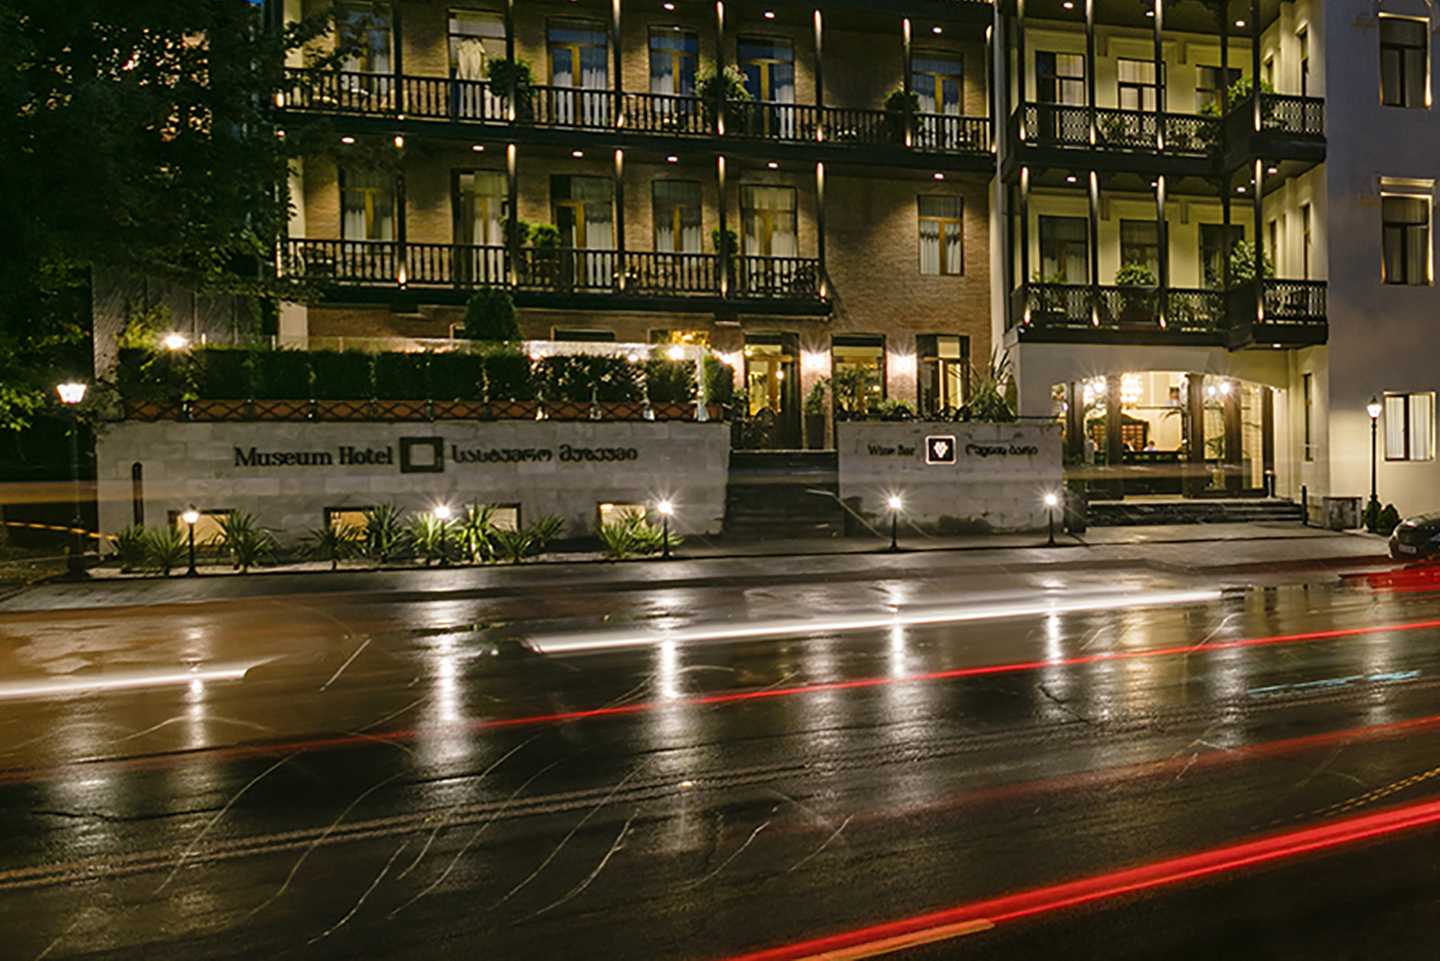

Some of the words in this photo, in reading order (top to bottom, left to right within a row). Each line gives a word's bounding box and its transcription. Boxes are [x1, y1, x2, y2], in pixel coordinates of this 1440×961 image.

[234, 447, 333, 467] Museum
[339, 446, 394, 465] Hotel
[451, 444, 554, 463] სასტუმრო
[559, 443, 638, 462] მუზეუმი
[867, 444, 895, 456] Wine
[898, 445, 916, 456] Bar
